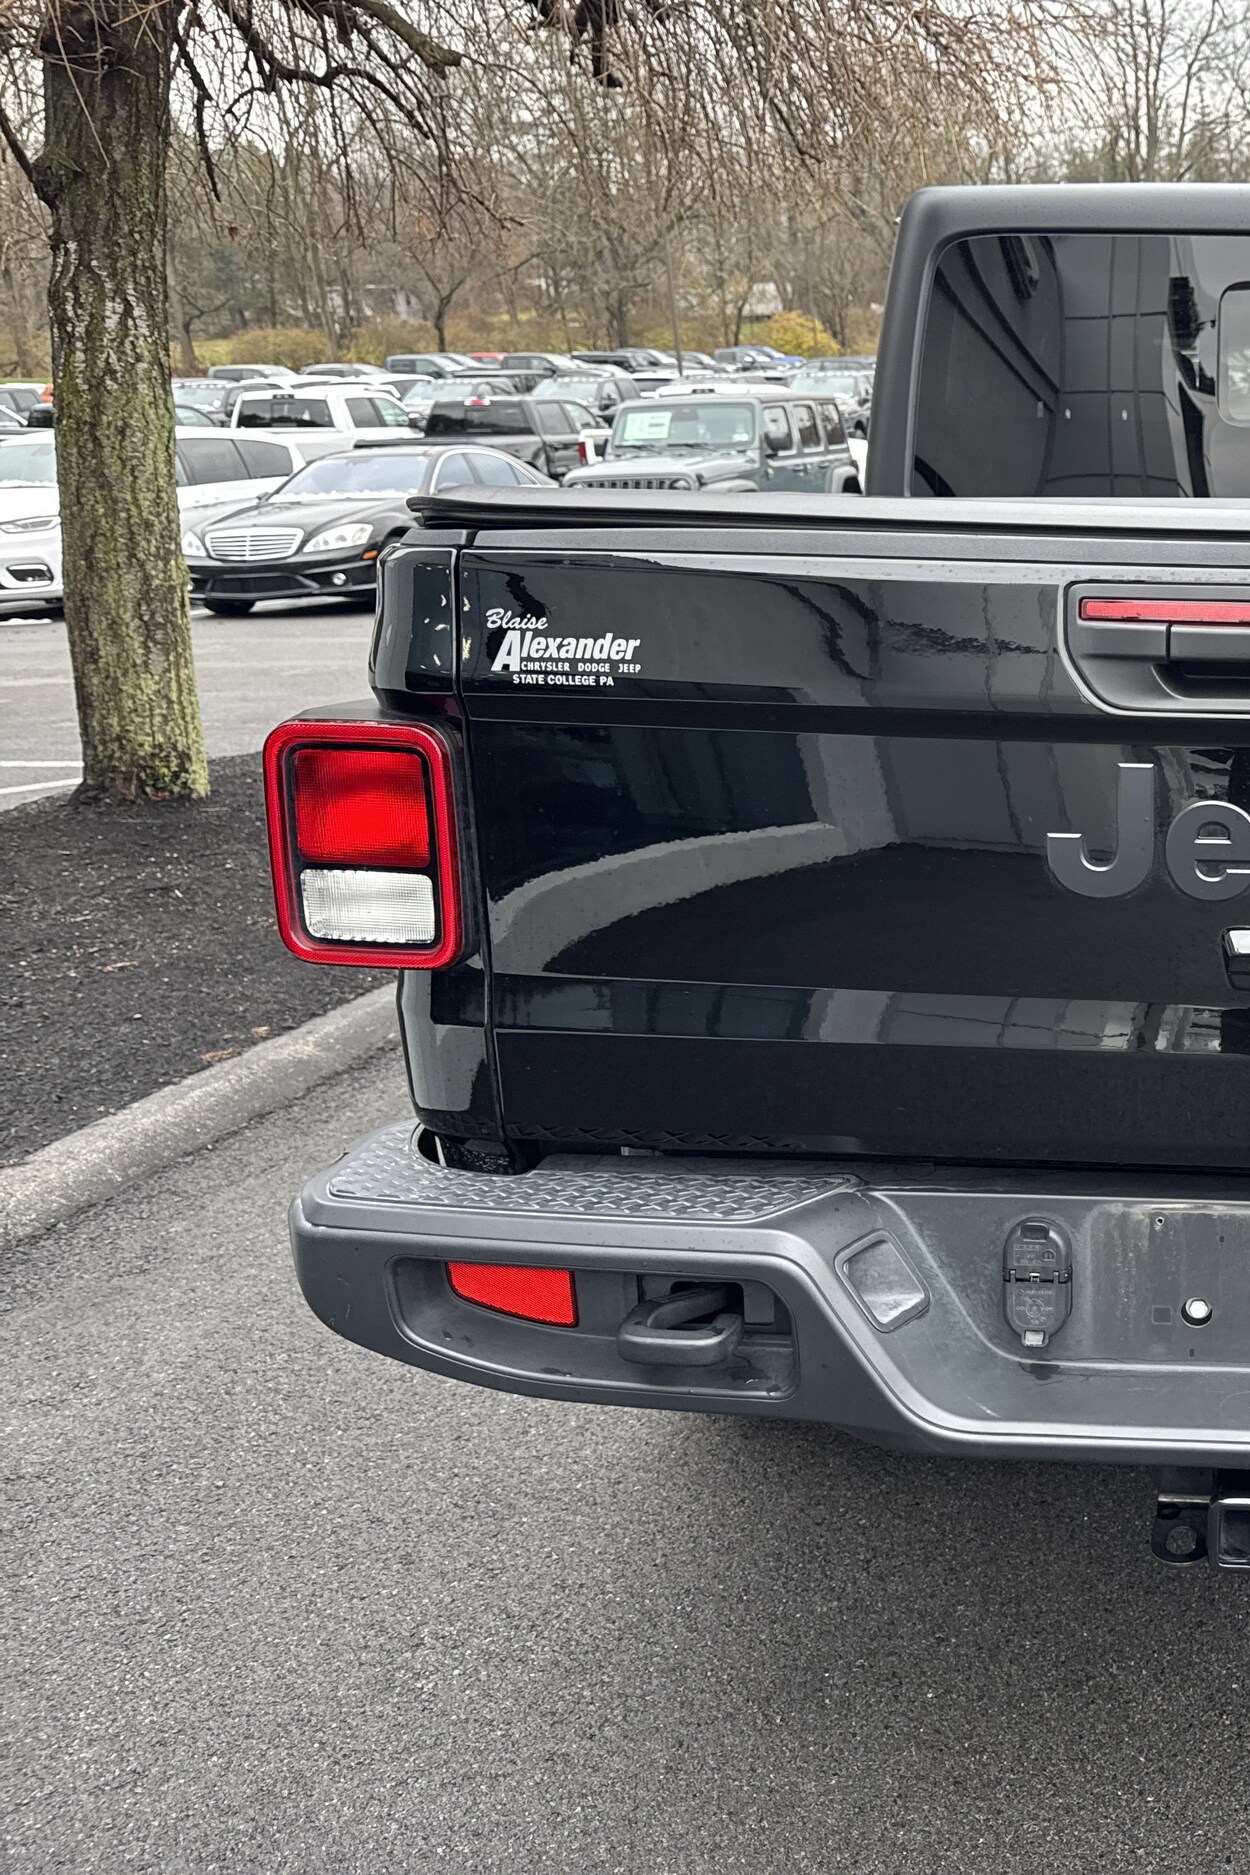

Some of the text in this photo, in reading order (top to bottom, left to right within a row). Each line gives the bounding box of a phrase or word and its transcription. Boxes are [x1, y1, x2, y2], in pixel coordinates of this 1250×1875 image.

[485, 608, 548, 630] Blaise
[490, 630, 641, 672] Alexander
[521, 661, 641, 673] CHRYSLER DODGE JEEP
[512, 674, 615, 687] STATE COLLEGE PA
